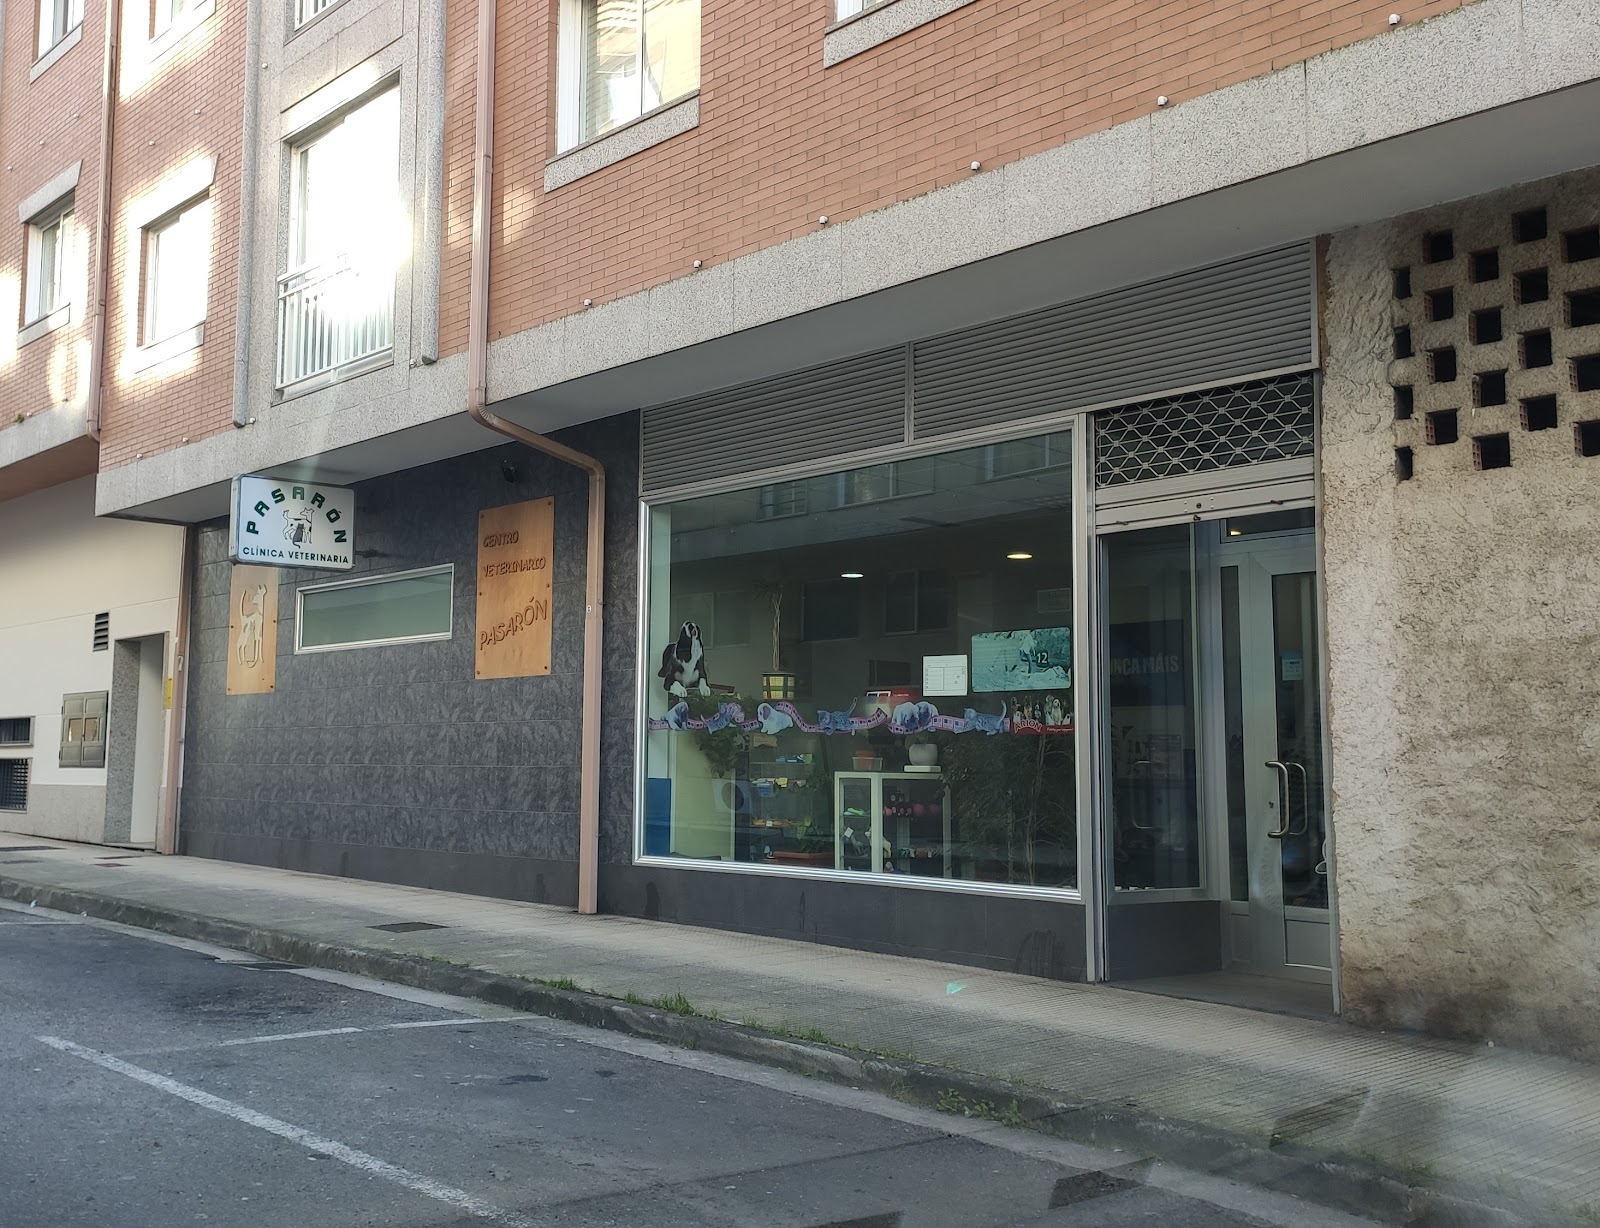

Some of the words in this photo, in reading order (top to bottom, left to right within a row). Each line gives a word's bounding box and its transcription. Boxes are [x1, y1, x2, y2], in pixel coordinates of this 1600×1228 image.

[246, 486, 347, 543] PASARÓN
[482, 530, 519, 548] CENTRO
[243, 546, 284, 558] CLÍNICA
[288, 550, 349, 564] VETERINARIA
[483, 556, 546, 578] VETERINARIO
[480, 596, 548, 651] PASARÓN
[1036, 652, 1048, 664] 12
[1111, 656, 1141, 675] NCA
[1013, 719, 1043, 734] ARION
